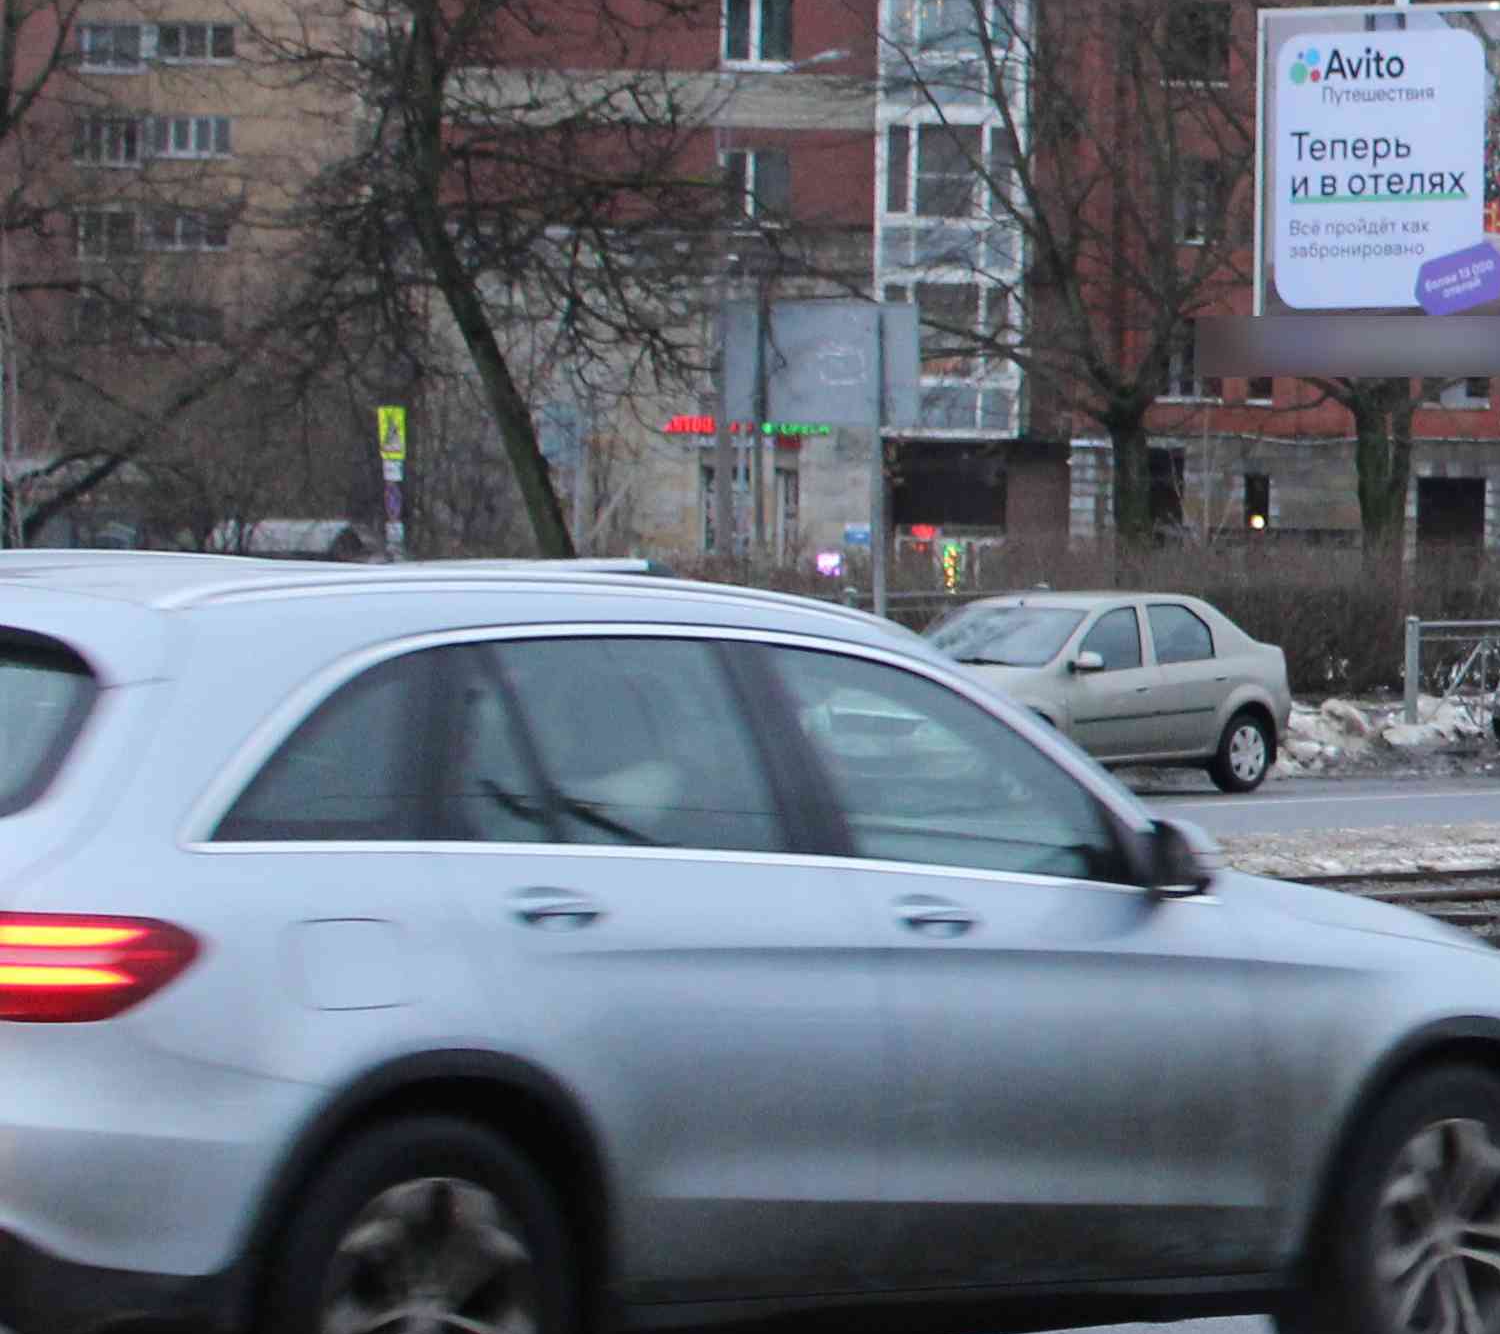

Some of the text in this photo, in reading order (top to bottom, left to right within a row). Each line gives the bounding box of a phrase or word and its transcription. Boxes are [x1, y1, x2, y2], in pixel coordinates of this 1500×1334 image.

[1324, 47, 1405, 80] Avito
[1322, 85, 1435, 106] Путешествия
[1290, 131, 1411, 167] Теперь
[1291, 172, 1466, 197] и в отелях
[1402, 219, 1430, 235] как
[1289, 241, 1424, 261] забронировано
